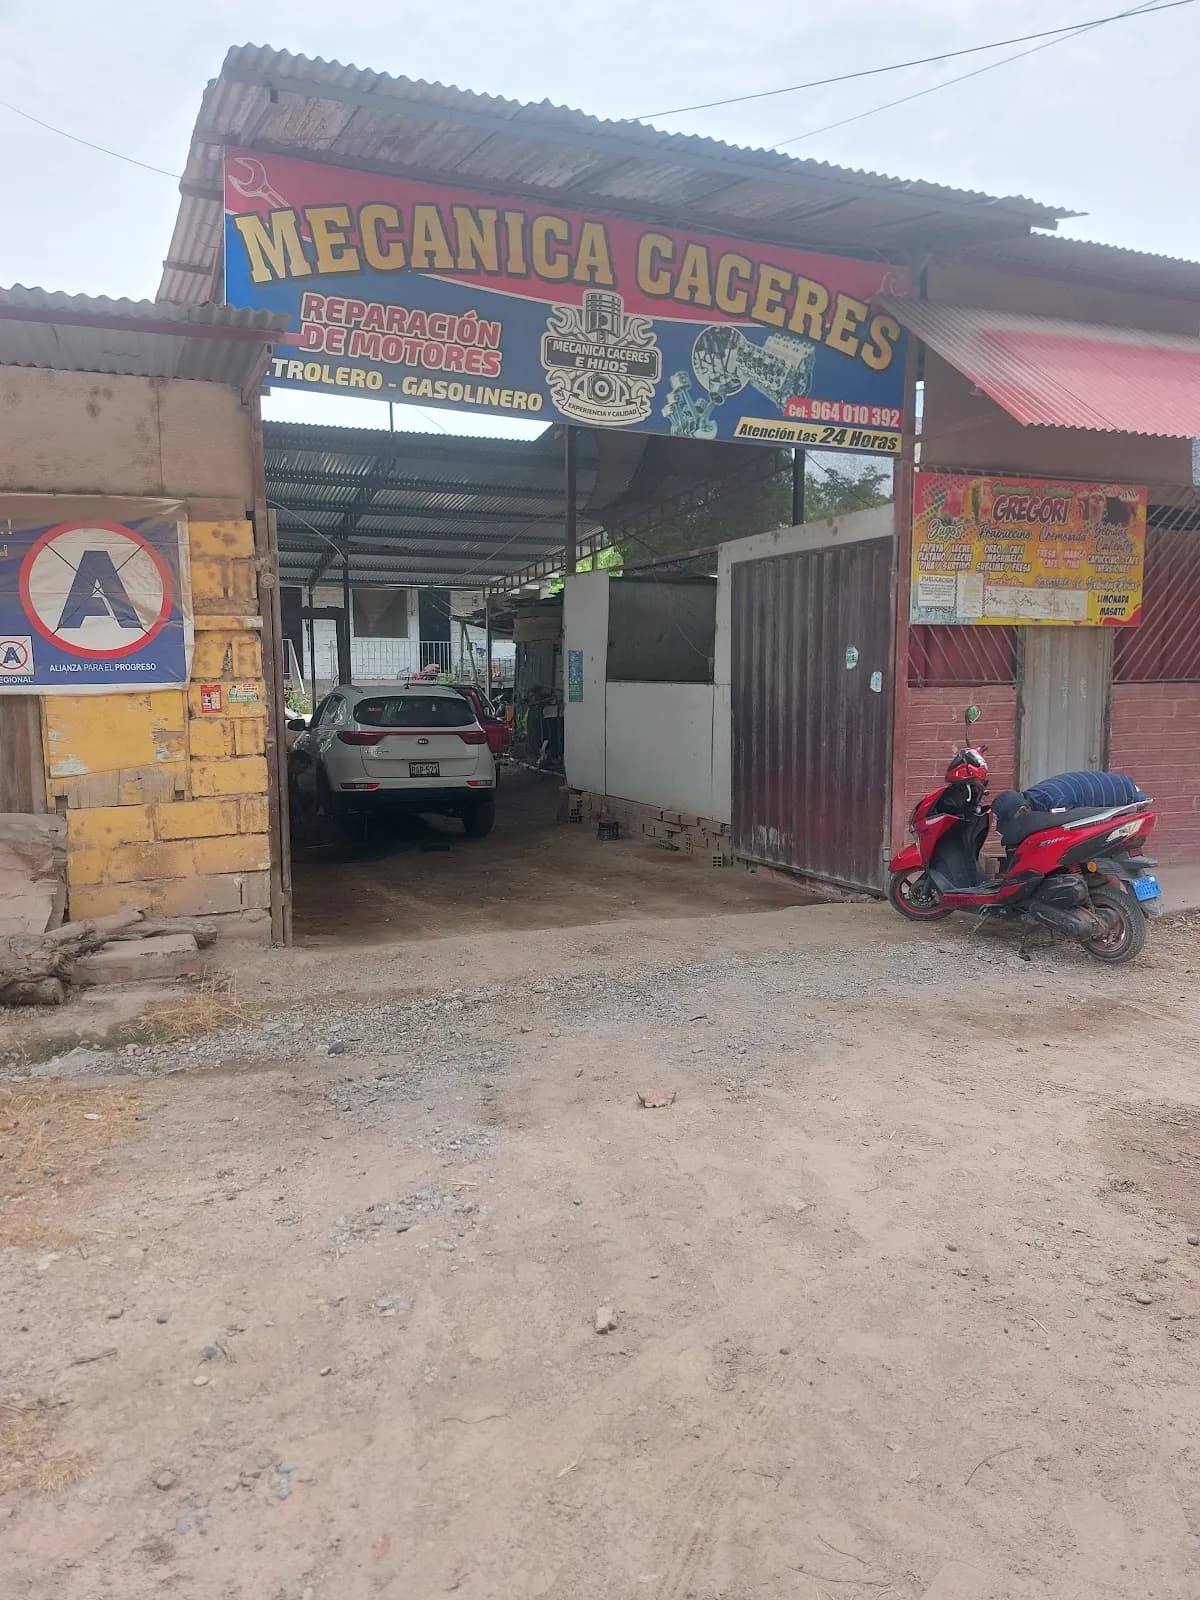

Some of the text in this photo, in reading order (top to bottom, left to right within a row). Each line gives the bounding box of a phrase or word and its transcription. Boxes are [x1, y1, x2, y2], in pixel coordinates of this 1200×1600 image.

[234, 204, 901, 371] MECANICA CACERES
[301, 292, 501, 348] REPARACIÓN
[299, 321, 502, 377] DE MOTORES
[552, 340, 651, 364] MECANICA CACERES
[575, 356, 629, 373] E HIJOS
[265, 358, 383, 390] TROLERO
[401, 376, 543, 411] GASOLINERO
[567, 403, 607, 417] EXPERIENCIA
[611, 408, 637, 417] CALIDAD
[788, 401, 900, 427] Cel: 964 010 392
[739, 422, 898, 450] Atención Las 24 Horas
[992, 496, 1069, 524] GREGORI
[56, 550, 145, 629] A
[1096, 595, 1129, 603] LIMONADA
[1099, 607, 1126, 616] MASATO
[3, 646, 21, 664] A
[50, 664, 82, 672] ALIANZA
[83, 664, 104, 672] PARA
[115, 663, 156, 671] PROGRESO
